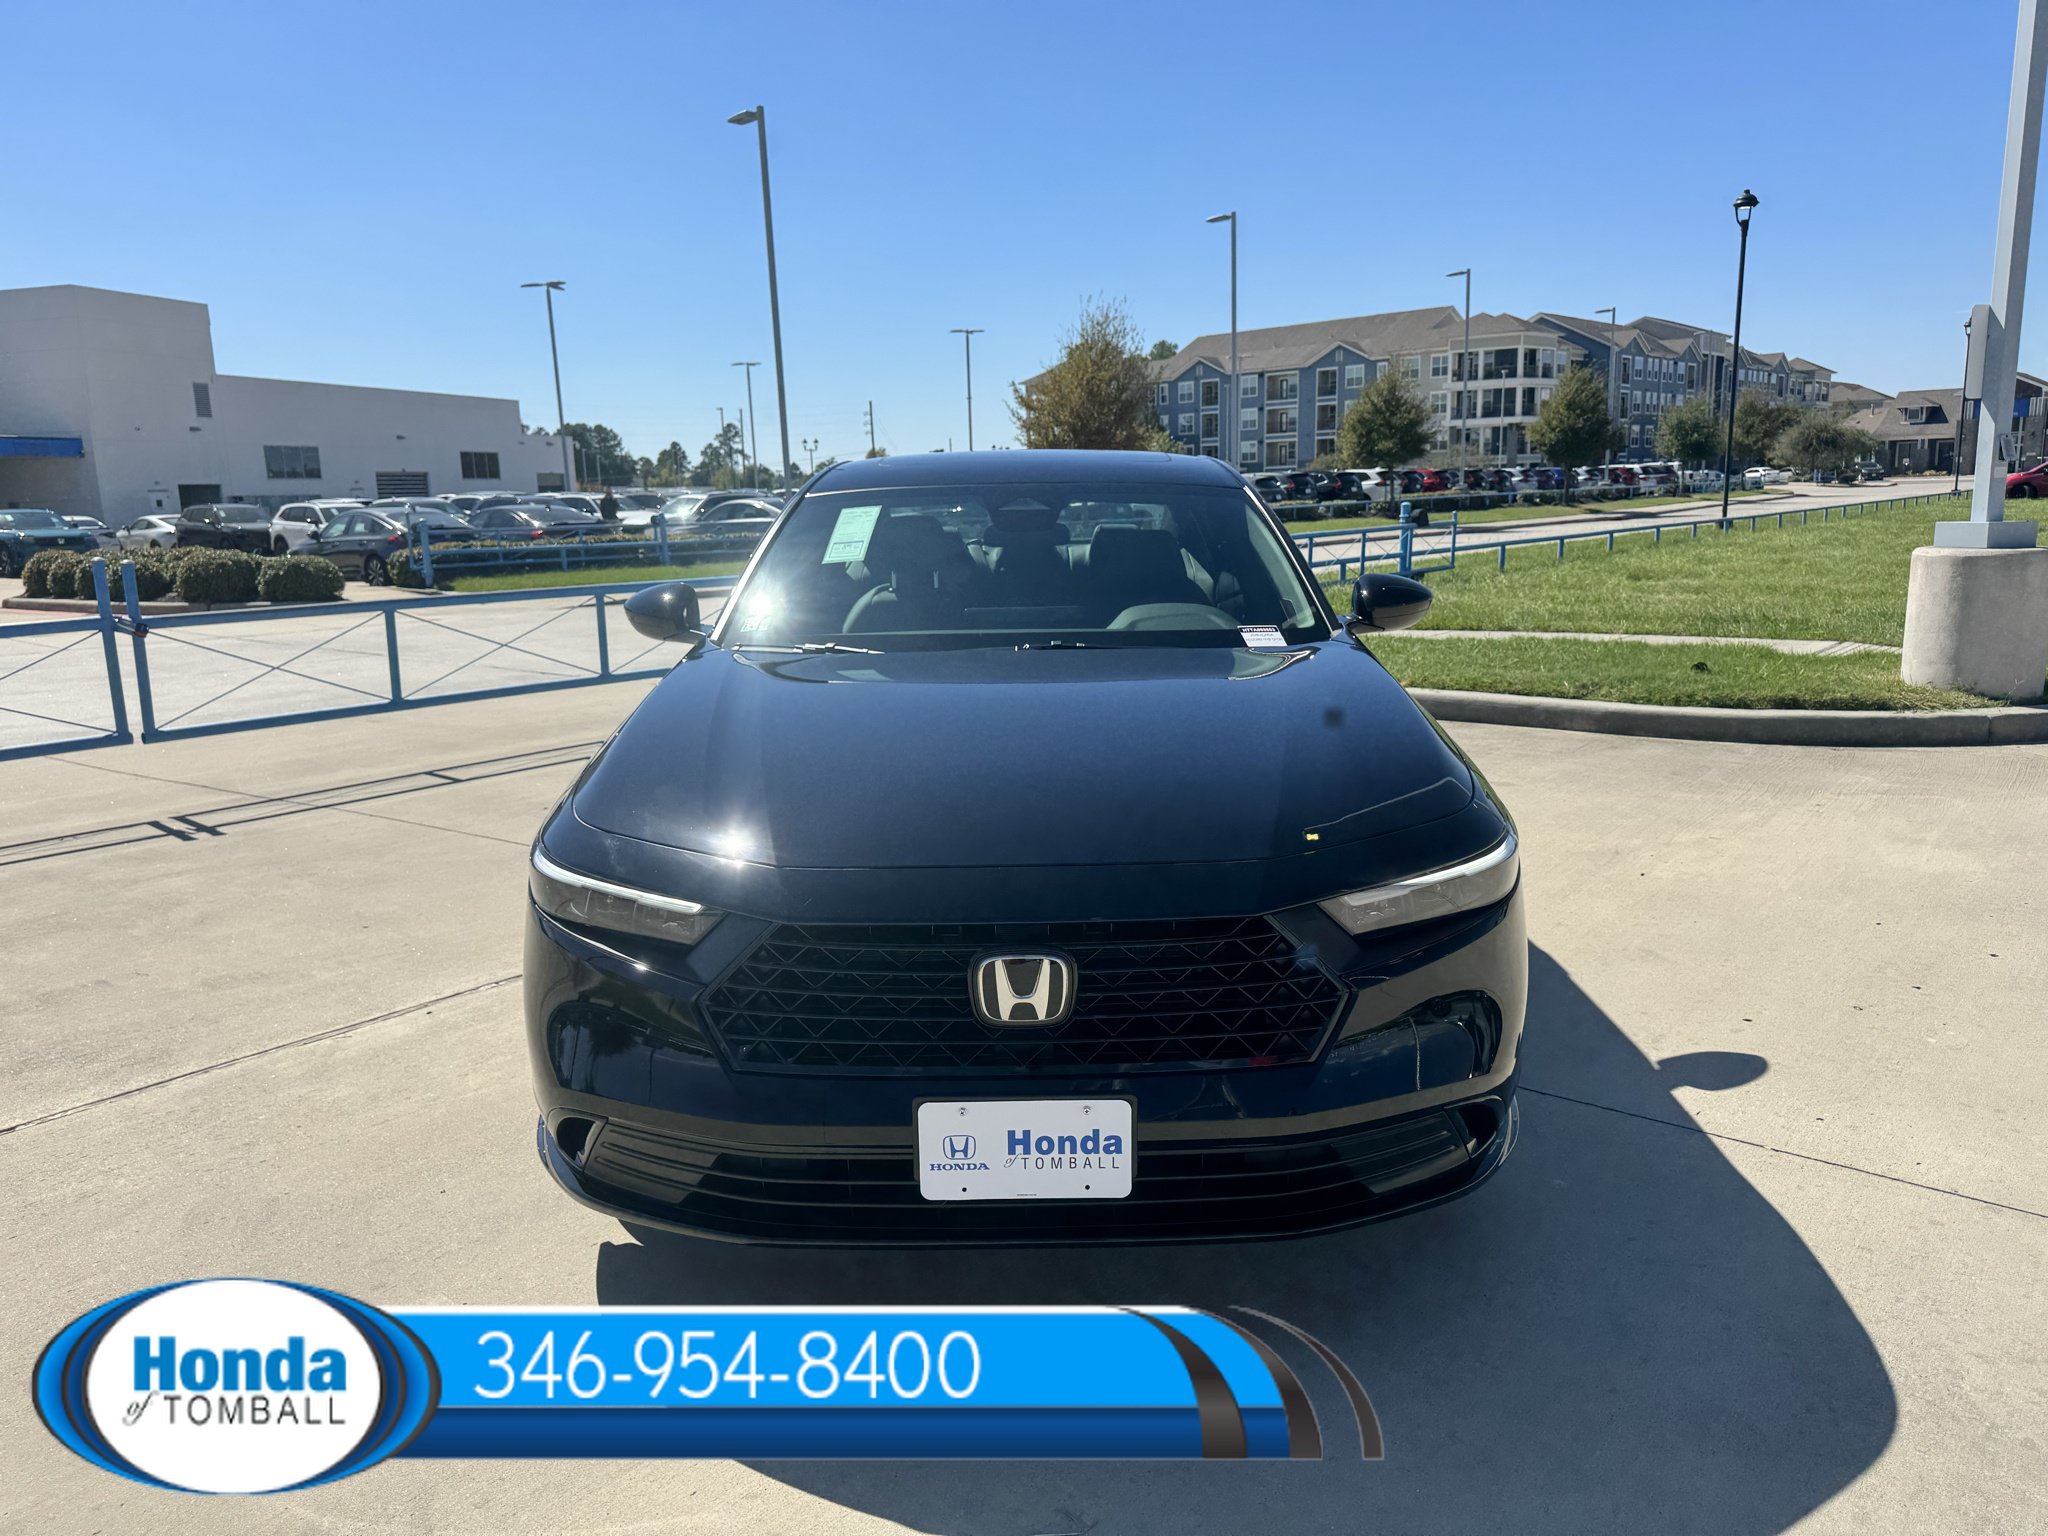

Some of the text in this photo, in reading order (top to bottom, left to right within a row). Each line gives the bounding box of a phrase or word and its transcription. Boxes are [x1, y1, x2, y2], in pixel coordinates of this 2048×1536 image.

[1007, 1129, 1123, 1155] Honda
[929, 1163, 990, 1171] HONDA
[1004, 1153, 1120, 1170] of TOMBALL
